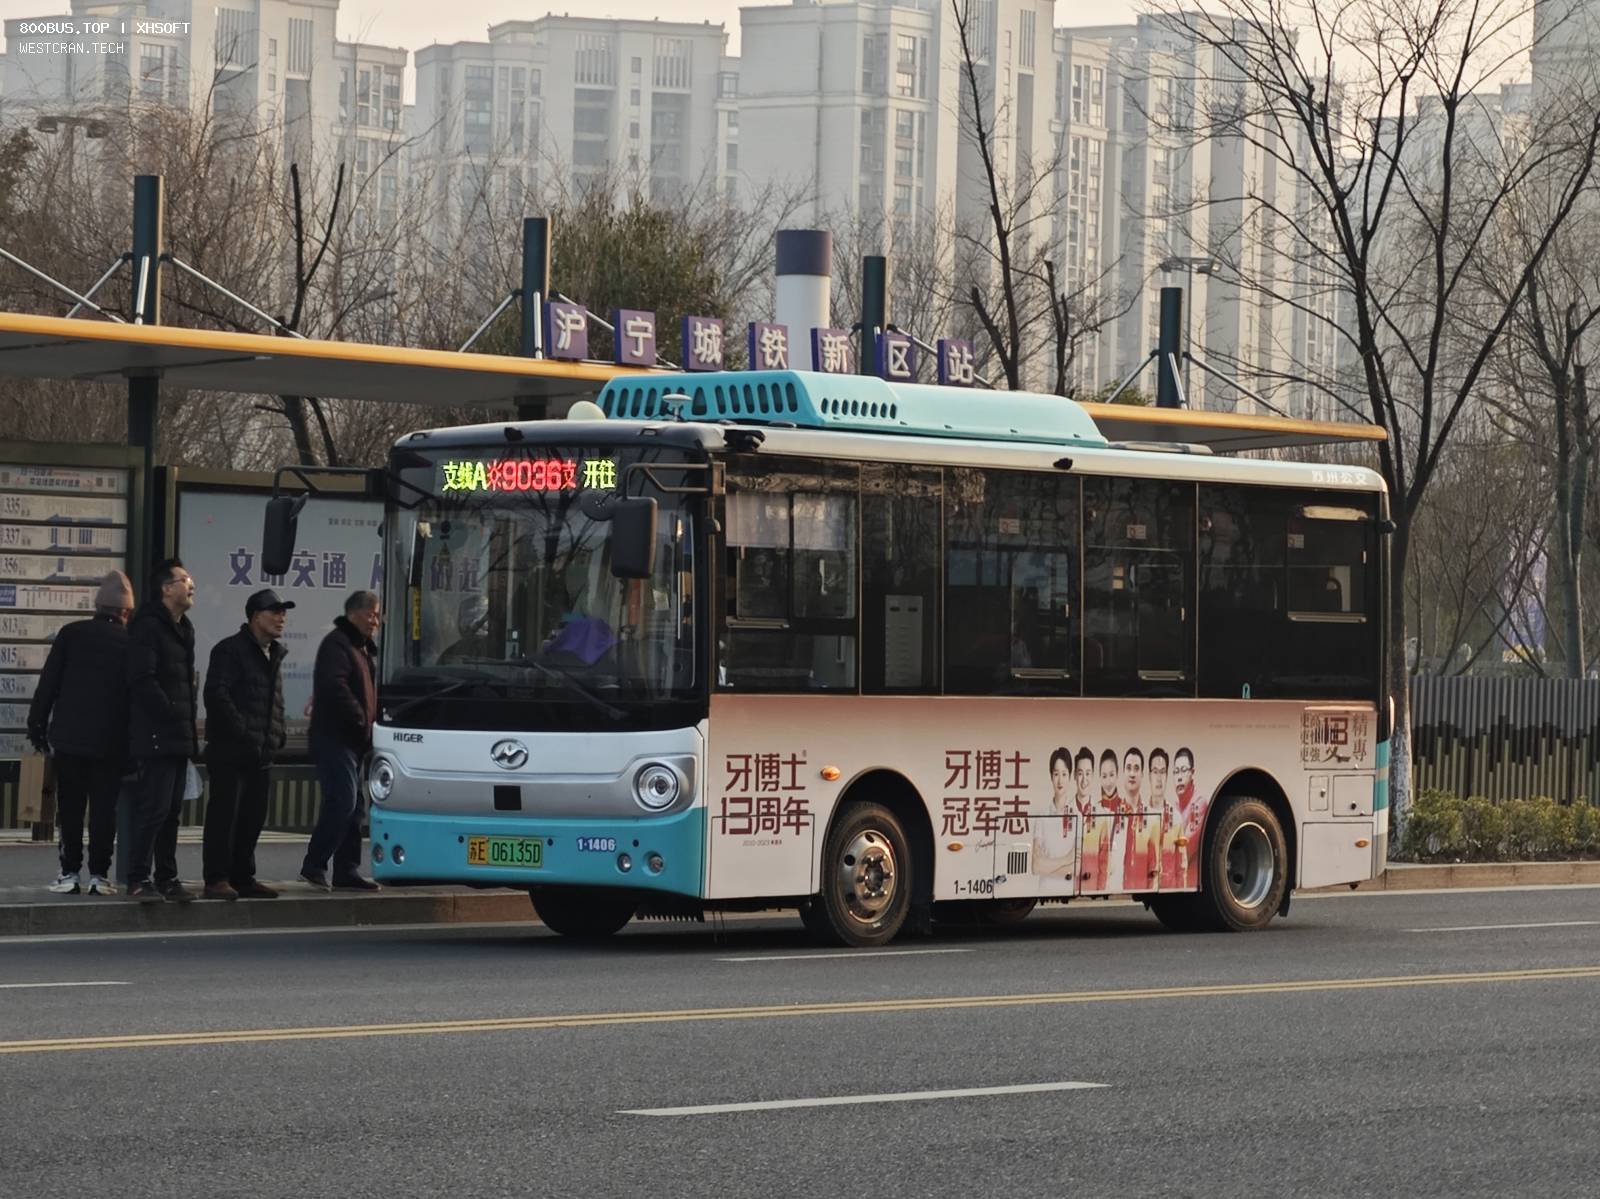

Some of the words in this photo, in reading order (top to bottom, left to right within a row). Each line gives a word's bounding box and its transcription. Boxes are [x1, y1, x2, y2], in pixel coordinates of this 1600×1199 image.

[556, 307, 974, 384] 沪宁城铁新区站
[1, 647, 17, 663] 815
[393, 732, 424, 744] HIGER
[725, 753, 808, 793] 牙博士
[944, 749, 1031, 790] 牙博士
[721, 796, 810, 836] 13周年
[941, 795, 1031, 837] 冠军志
[491, 841, 541, 864] 06135D
[953, 878, 994, 895] 1-1406
